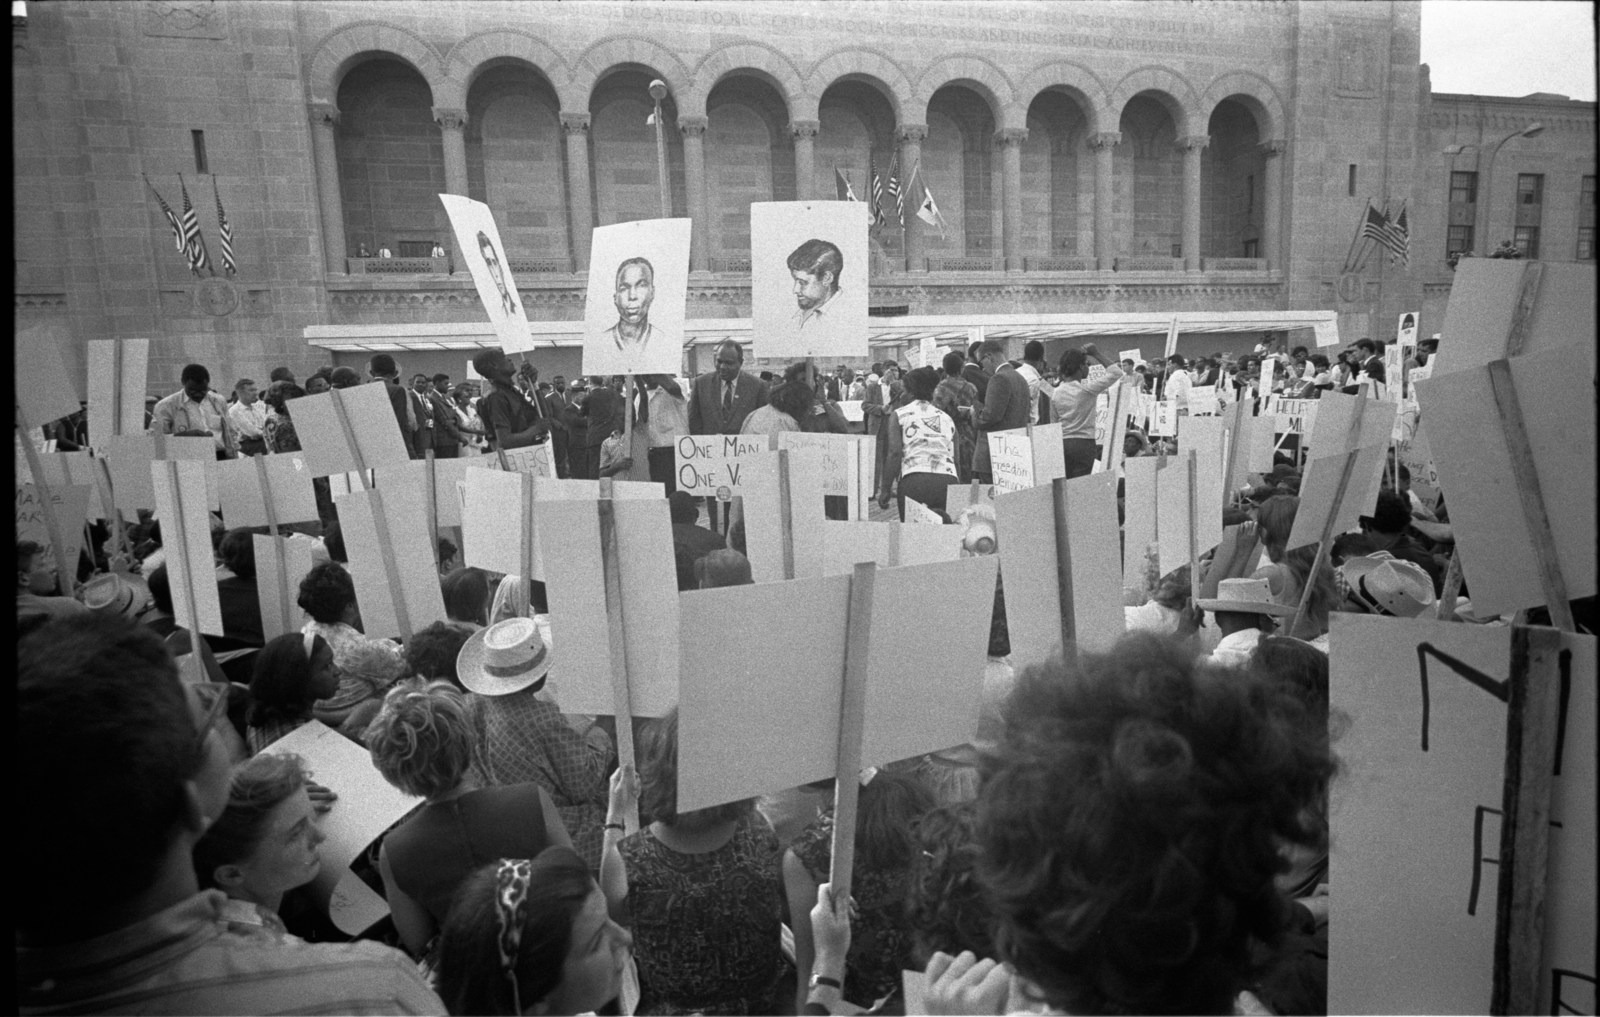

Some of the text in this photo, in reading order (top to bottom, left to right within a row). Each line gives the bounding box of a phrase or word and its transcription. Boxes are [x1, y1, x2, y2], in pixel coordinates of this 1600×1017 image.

[601, 5, 696, 23] DEDICATED
[700, 11, 723, 25] TO
[730, 12, 829, 31] RECREATION
[834, 18, 896, 36] SOCIAL
[900, 22, 976, 41] PROGRESS
[980, 27, 1009, 43] AND
[678, 435, 713, 460] ONE
[723, 436, 759, 458] MAN
[993, 435, 1022, 458] The
[679, 463, 716, 489] ONE
